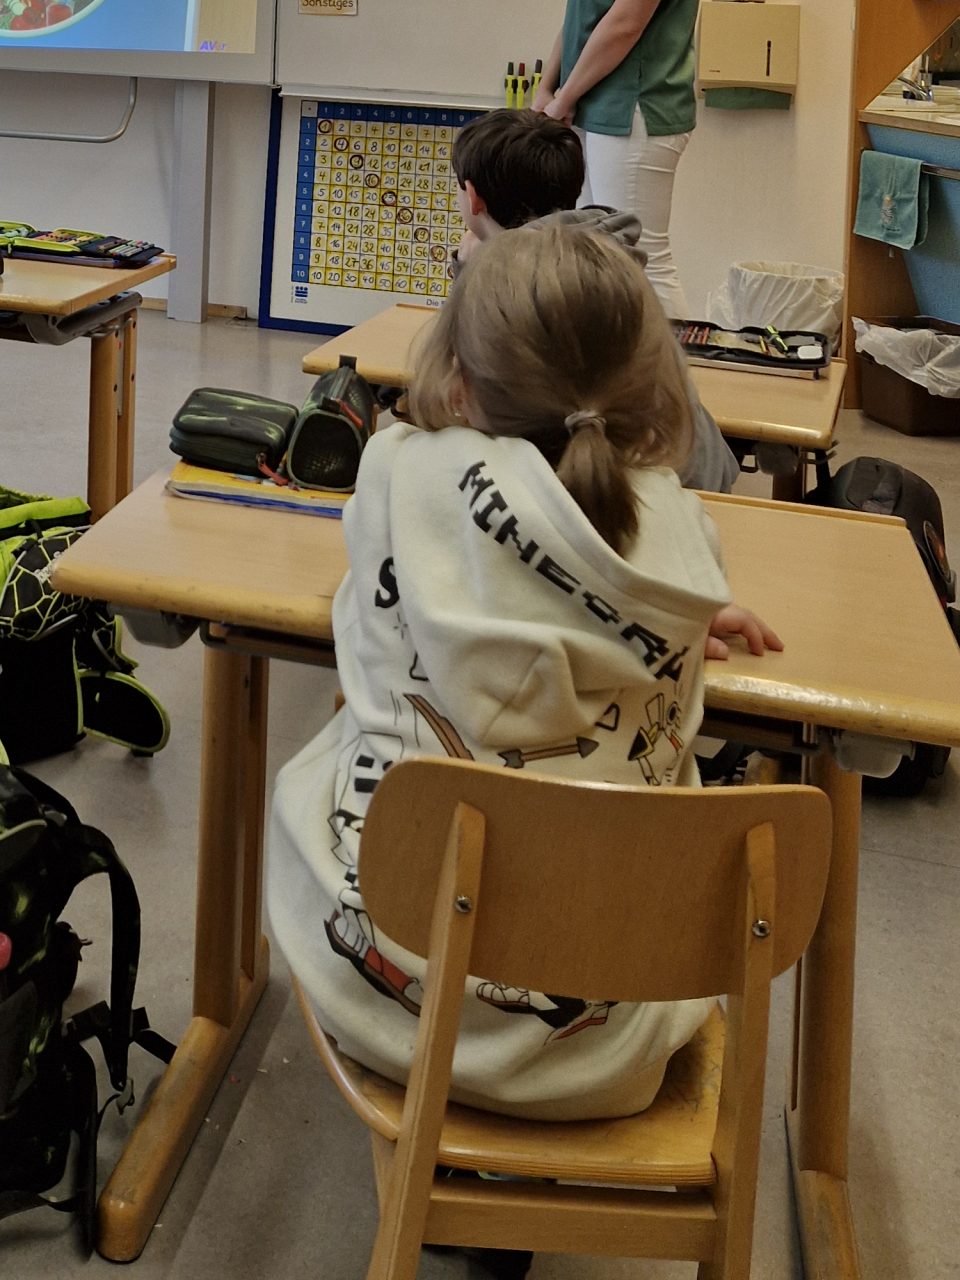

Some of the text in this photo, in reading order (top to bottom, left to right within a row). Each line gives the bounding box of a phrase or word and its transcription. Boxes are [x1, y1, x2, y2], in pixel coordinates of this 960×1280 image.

[338, 123, 345, 132] 2
[355, 124, 362, 133] 3
[371, 126, 379, 134] 4
[388, 125, 397, 135] 5
[405, 128, 413, 137] 6
[354, 141, 360, 151] 6
[370, 141, 378, 152] 8
[385, 143, 396, 153] 10
[403, 144, 413, 153] 12
[419, 145, 430, 154] 14
[321, 155, 327, 164] 3
[336, 156, 343, 166] 6
[368, 159, 379, 169] 12
[319, 171, 326, 180] 4
[335, 172, 342, 182] 8
[317, 188, 326, 197] 5
[332, 189, 342, 199] 10
[348, 190, 359, 199] 15
[365, 192, 377, 201] 20
[317, 205, 325, 214] 6
[332, 206, 342, 216] 12
[347, 207, 360, 217] 18
[364, 208, 376, 219] 24
[331, 222, 341, 232] 14
[347, 223, 359, 233] 21
[362, 225, 375, 237] 28
[315, 237, 322, 248] 8
[330, 239, 340, 248] 16
[347, 241, 358, 252] 24
[362, 241, 375, 253] 32
[314, 253, 320, 264] 9
[329, 255, 339, 265] 18
[311, 270, 322, 280] 10
[329, 272, 340, 282] 20
[344, 274, 357, 283] 30
